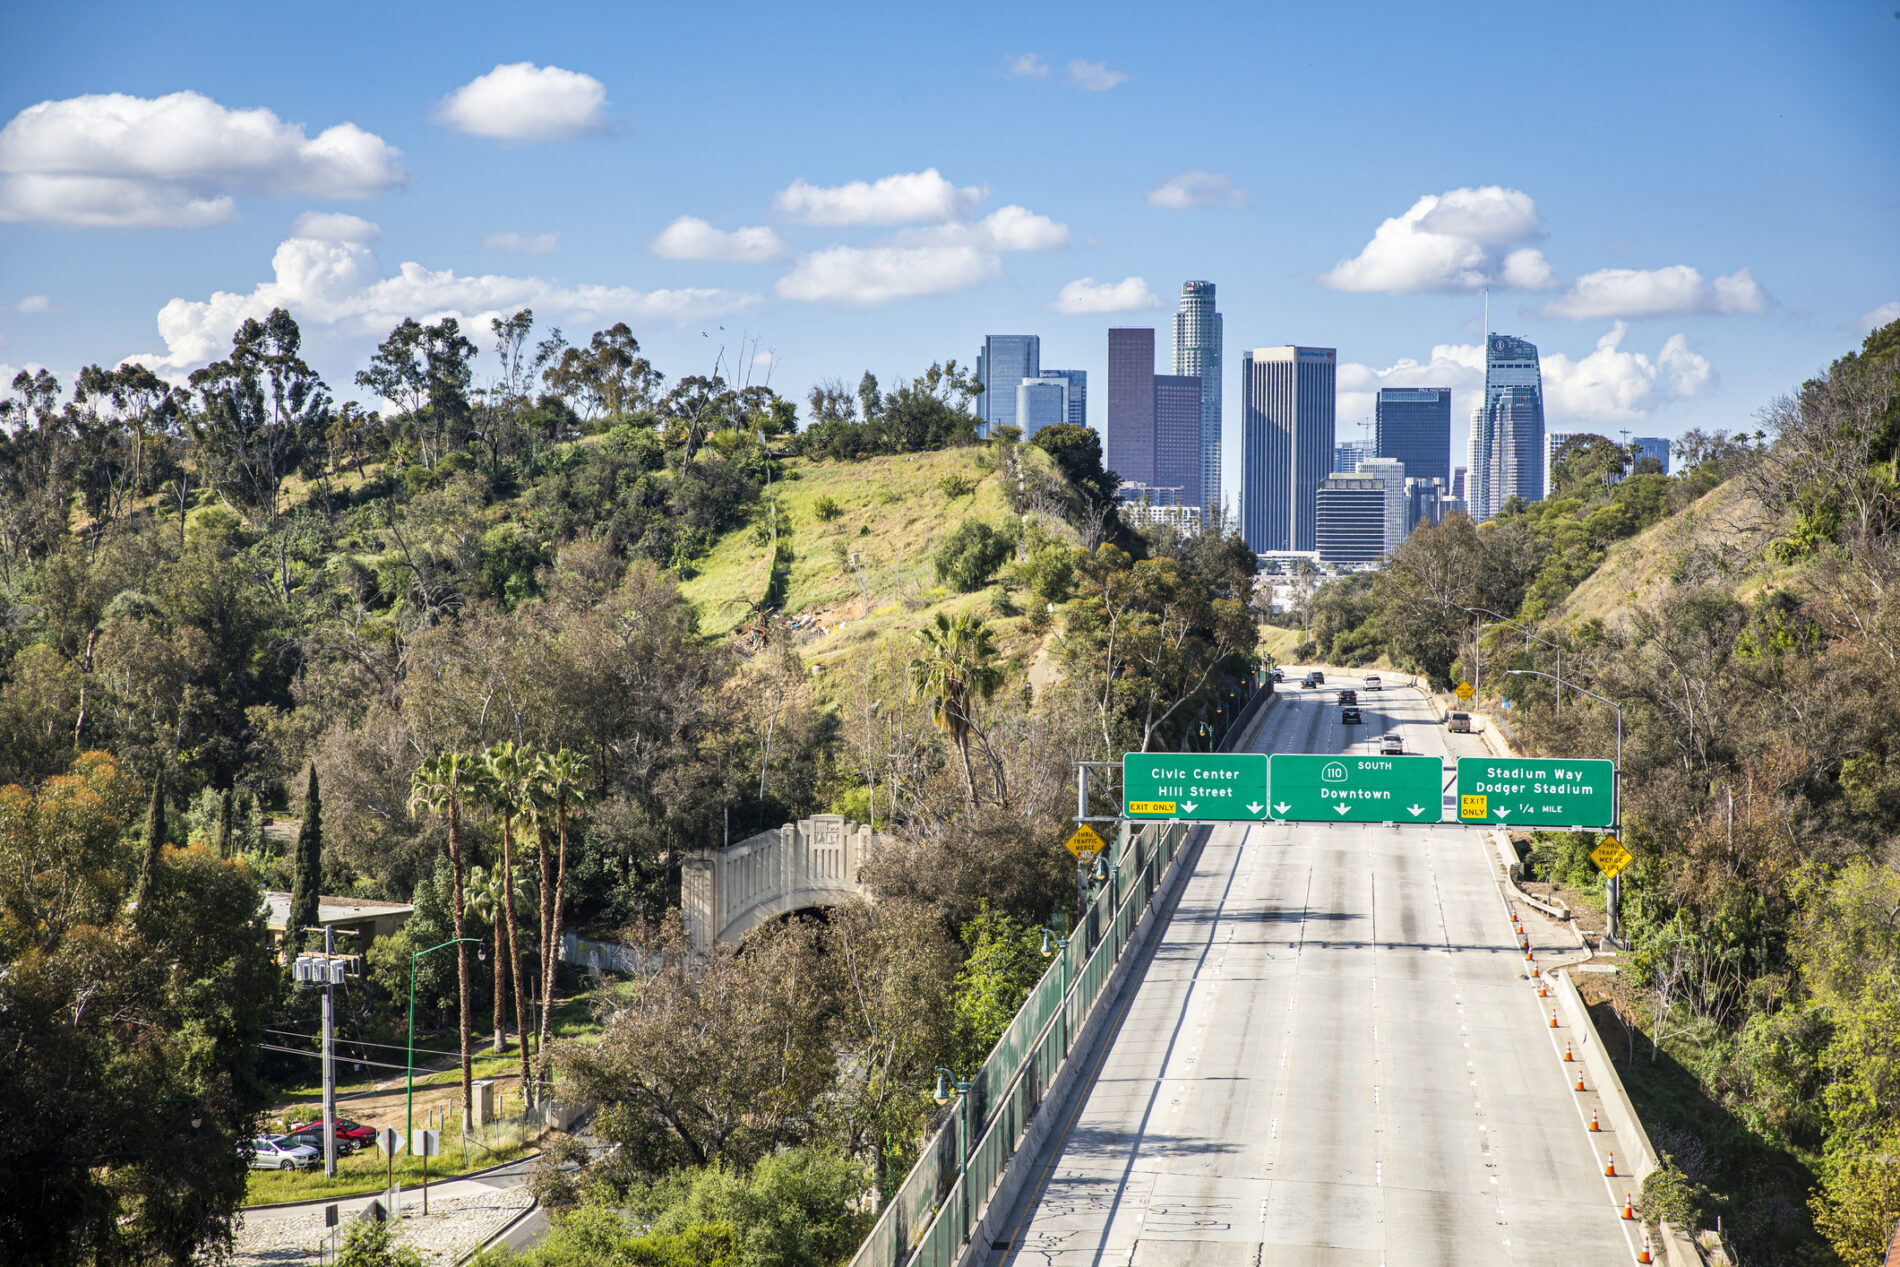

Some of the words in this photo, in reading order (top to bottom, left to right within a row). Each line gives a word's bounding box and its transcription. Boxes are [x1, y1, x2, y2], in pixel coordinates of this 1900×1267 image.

[1358, 762, 1392, 770] SOUTH
[1151, 768, 1186, 779] Civic
[1193, 769, 1239, 780] Center
[1327, 768, 1342, 778] 110
[1487, 768, 1546, 779] Stadium
[1554, 769, 1583, 782] Way
[1158, 786, 1183, 797] Hill
[1190, 786, 1232, 797] Street
[1321, 788, 1391, 799] Downtown
[1476, 782, 1526, 796] Dodger
[1533, 783, 1593, 795] Stadium
[1463, 797, 1485, 805] EXIT
[1519, 804, 1534, 814] 1/4
[1542, 805, 1563, 813] MILE
